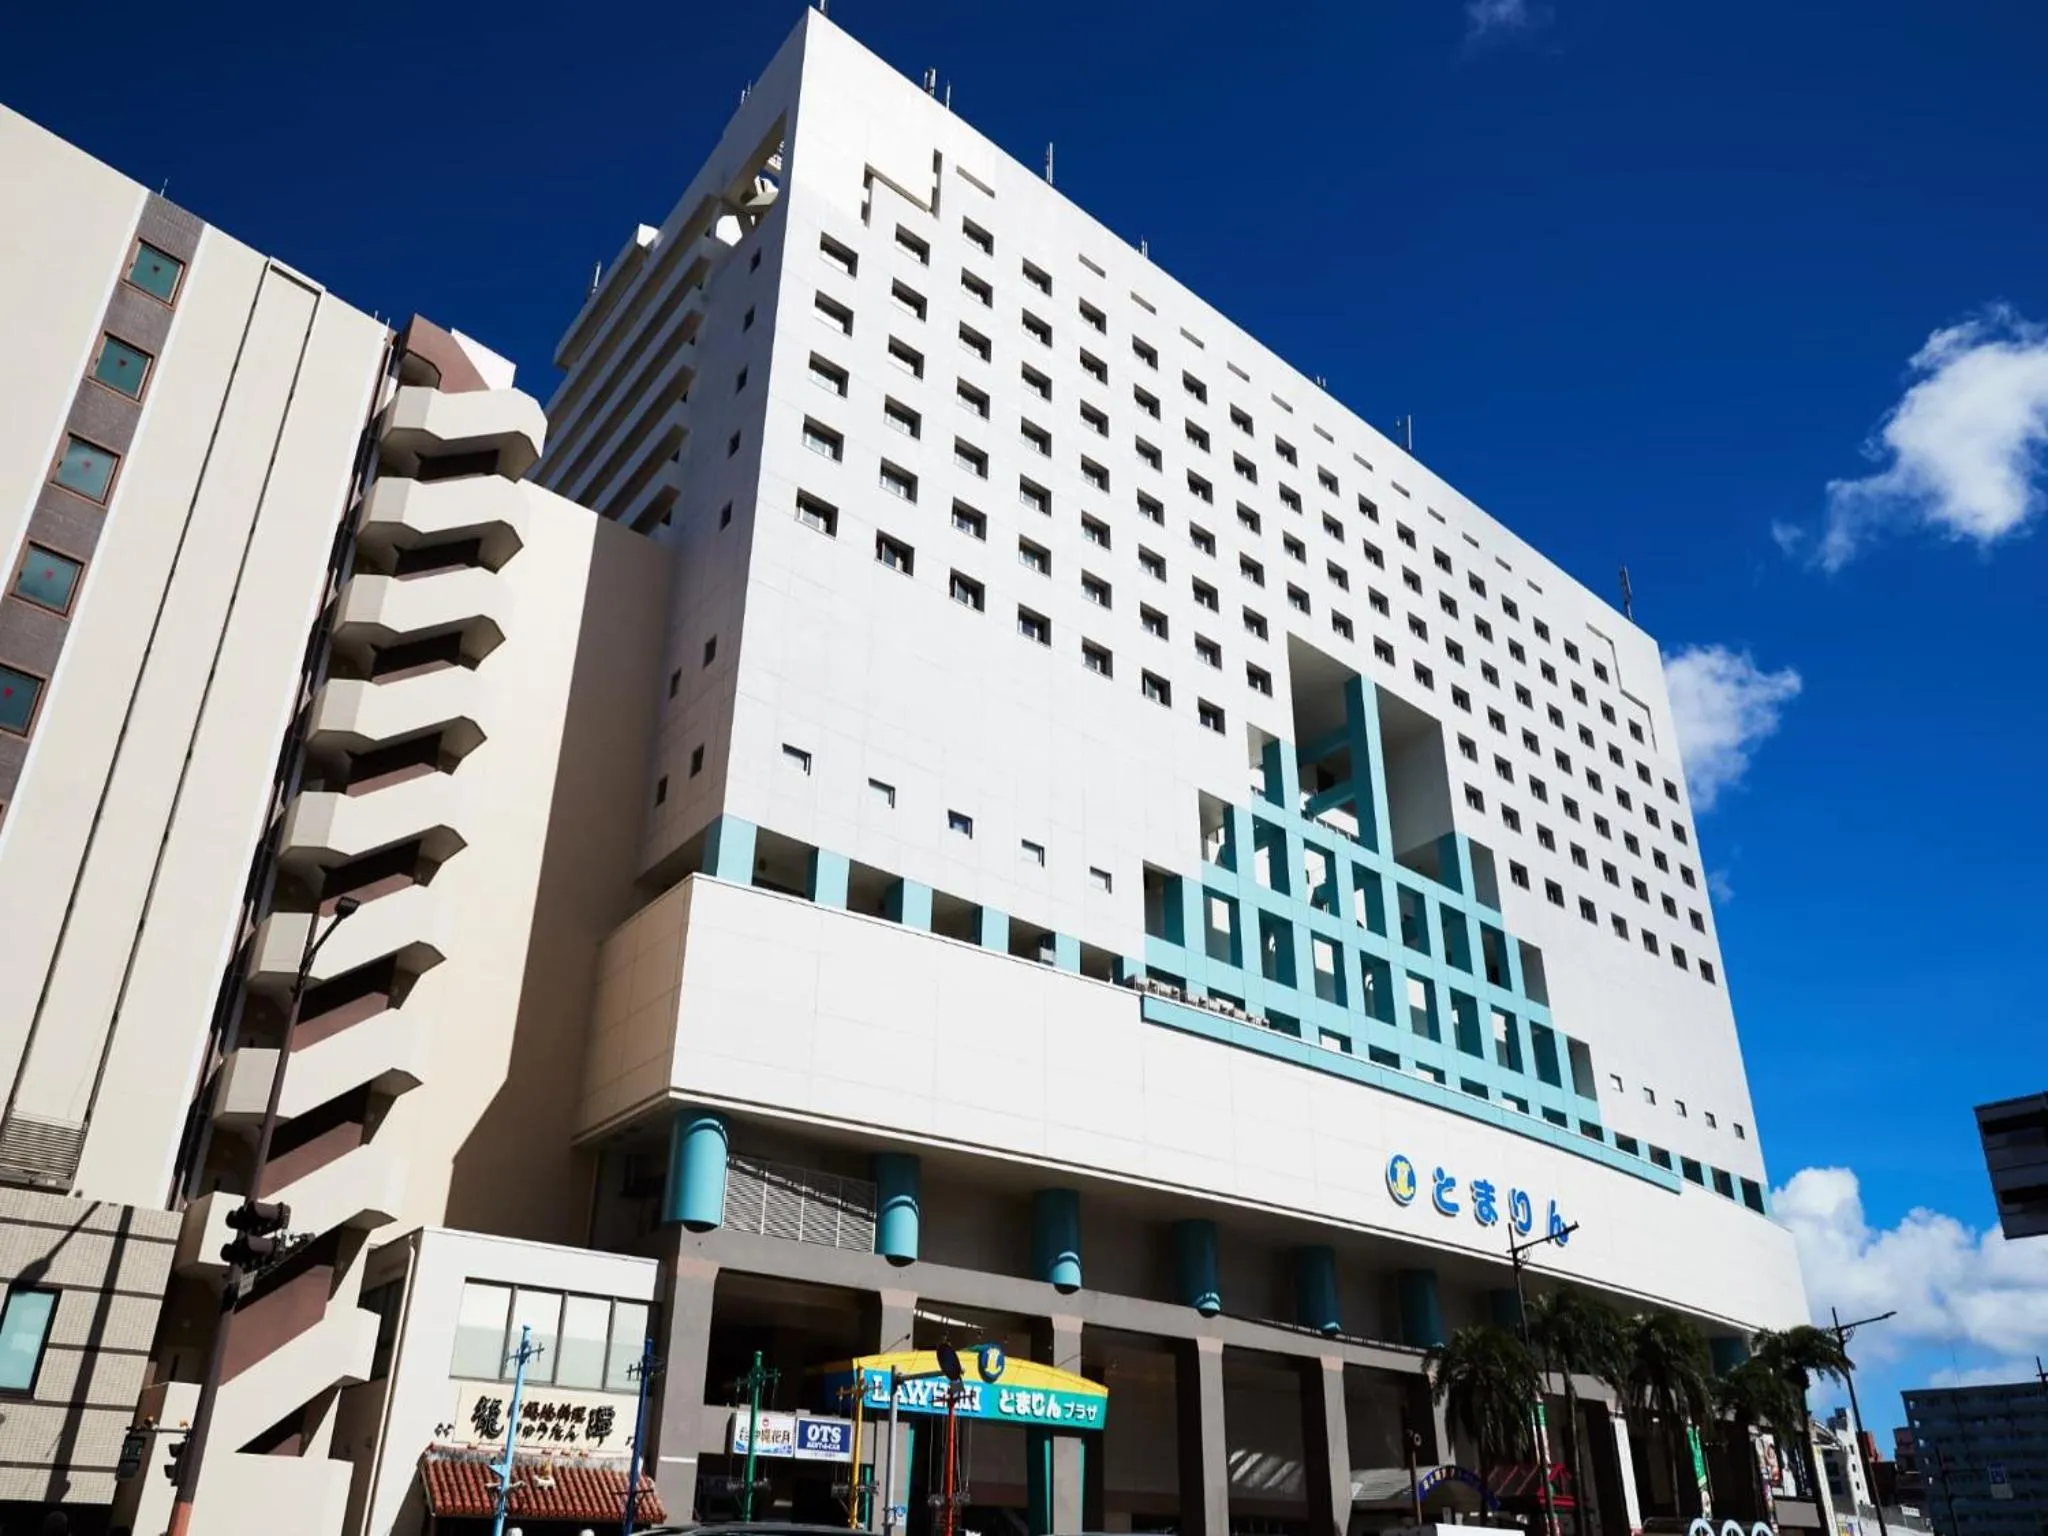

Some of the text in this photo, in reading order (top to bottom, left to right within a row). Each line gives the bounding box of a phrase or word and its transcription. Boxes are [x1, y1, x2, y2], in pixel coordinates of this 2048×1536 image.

[1432, 1166, 1569, 1245] とまりん
[872, 1375, 982, 1411] LAWSN
[807, 1424, 841, 1443] OTS
